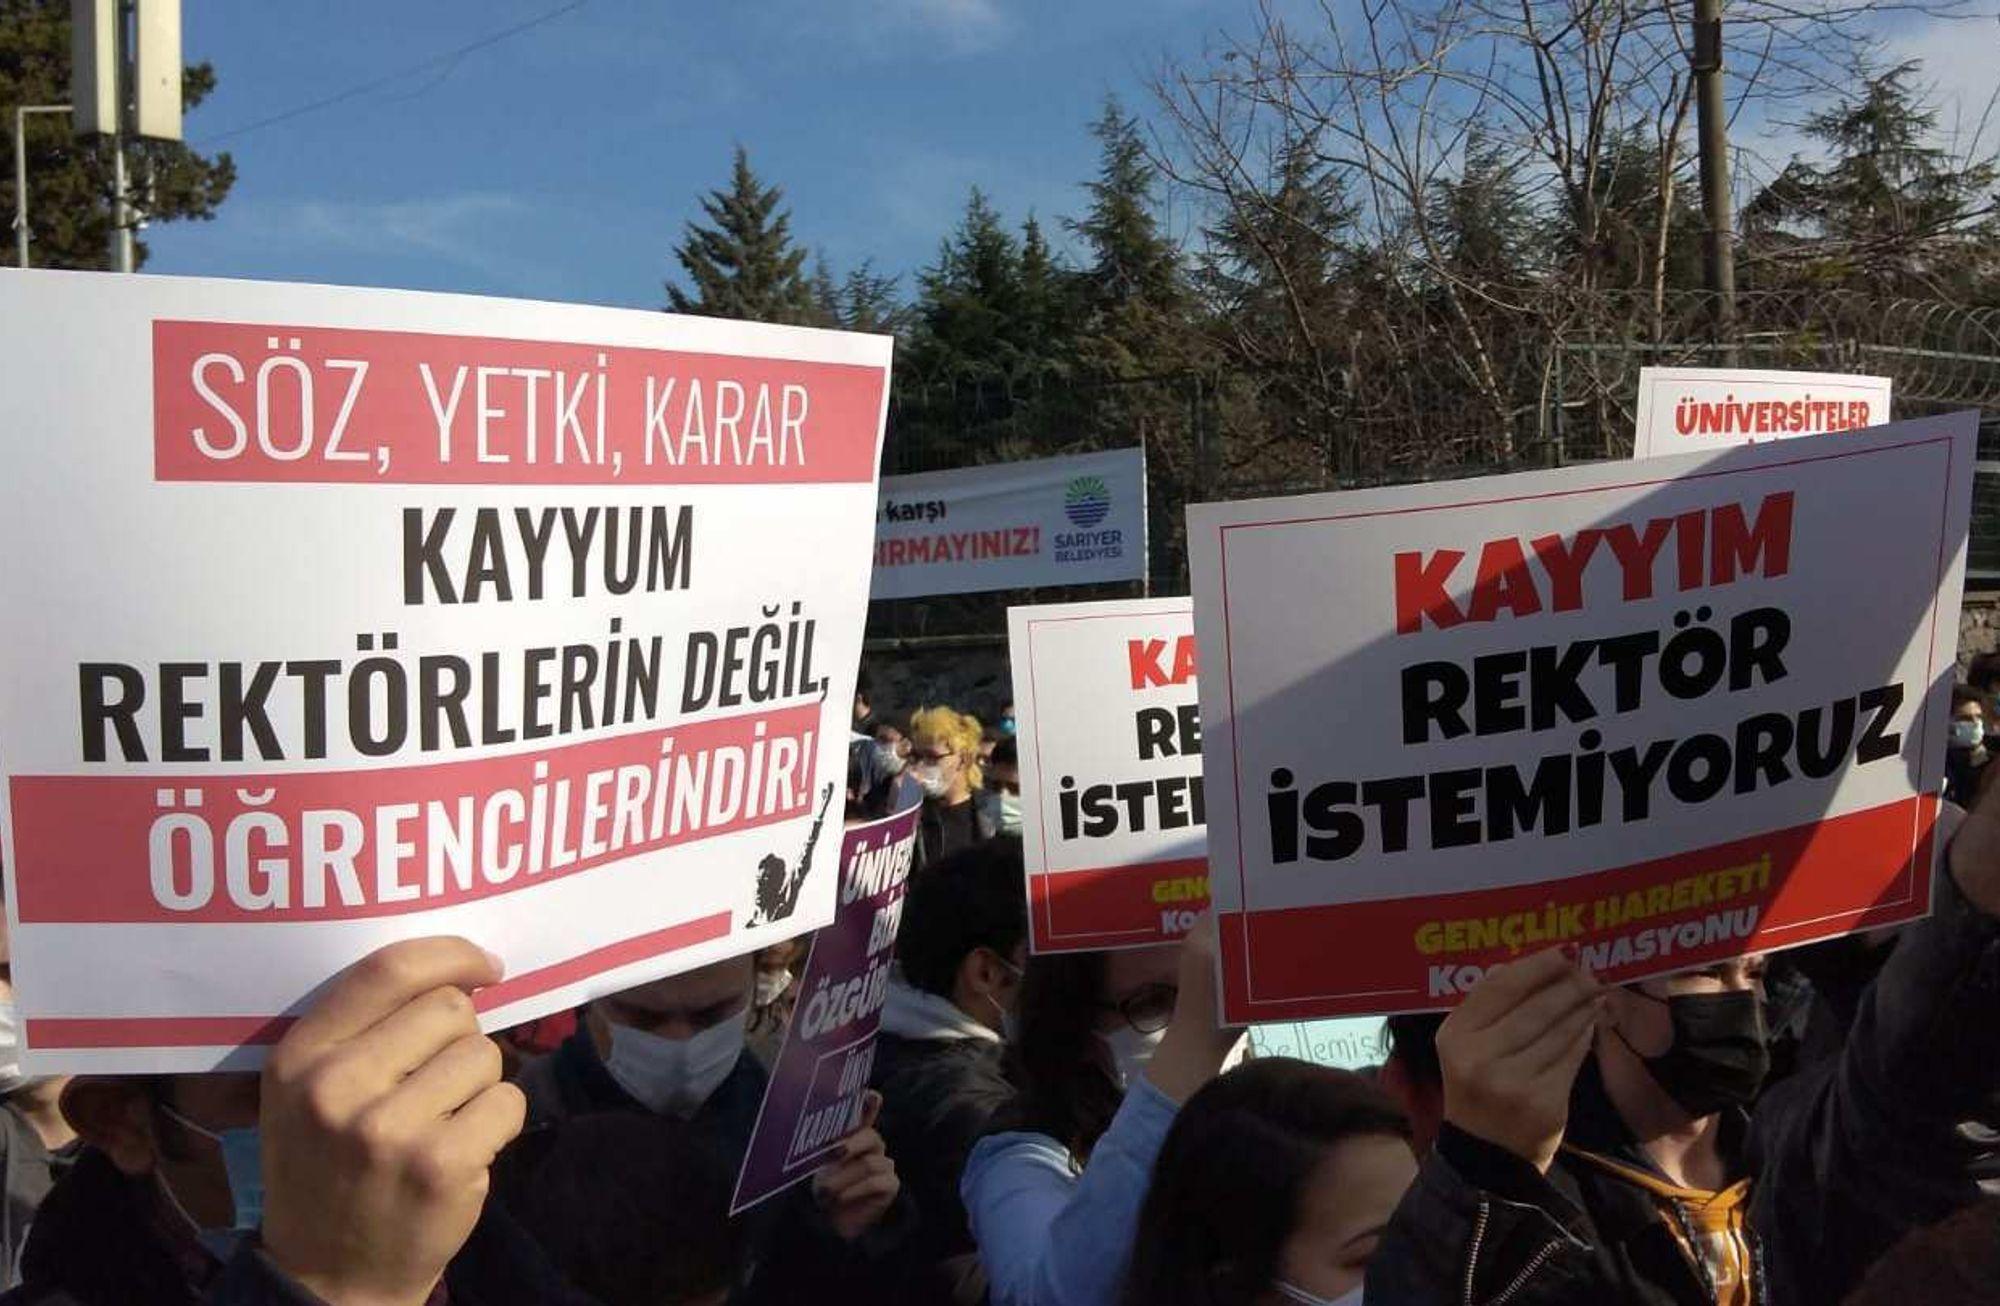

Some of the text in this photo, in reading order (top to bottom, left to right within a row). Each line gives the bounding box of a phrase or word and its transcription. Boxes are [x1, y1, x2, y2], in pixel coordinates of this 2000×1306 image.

[192, 337, 809, 477] SÖZ, YETKİ, KARAR
[1676, 394, 1870, 436] ÜNİVERSİTELER
[403, 505, 693, 605] KAYYUM
[873, 526, 1040, 568] IRMAYINIZ!
[886, 499, 947, 524] karşı
[1054, 530, 1122, 549] SARIYER
[1394, 491, 1795, 635] KAYYIM
[78, 601, 830, 763] REKTÖRLERİN DEĞİL,
[1128, 634, 1200, 690] KA
[1400, 606, 1791, 745] REKTÖR
[1136, 704, 1204, 760] RE
[1267, 683, 1905, 864] İSTEMİYORUZ
[148, 722, 818, 911] ÖĞRENCİLERİNDİR!
[1161, 909, 1198, 934] KO
[1415, 853, 1772, 955] GENÇLİK HAREKETİ
[1427, 905, 1760, 998] KONASYONU
